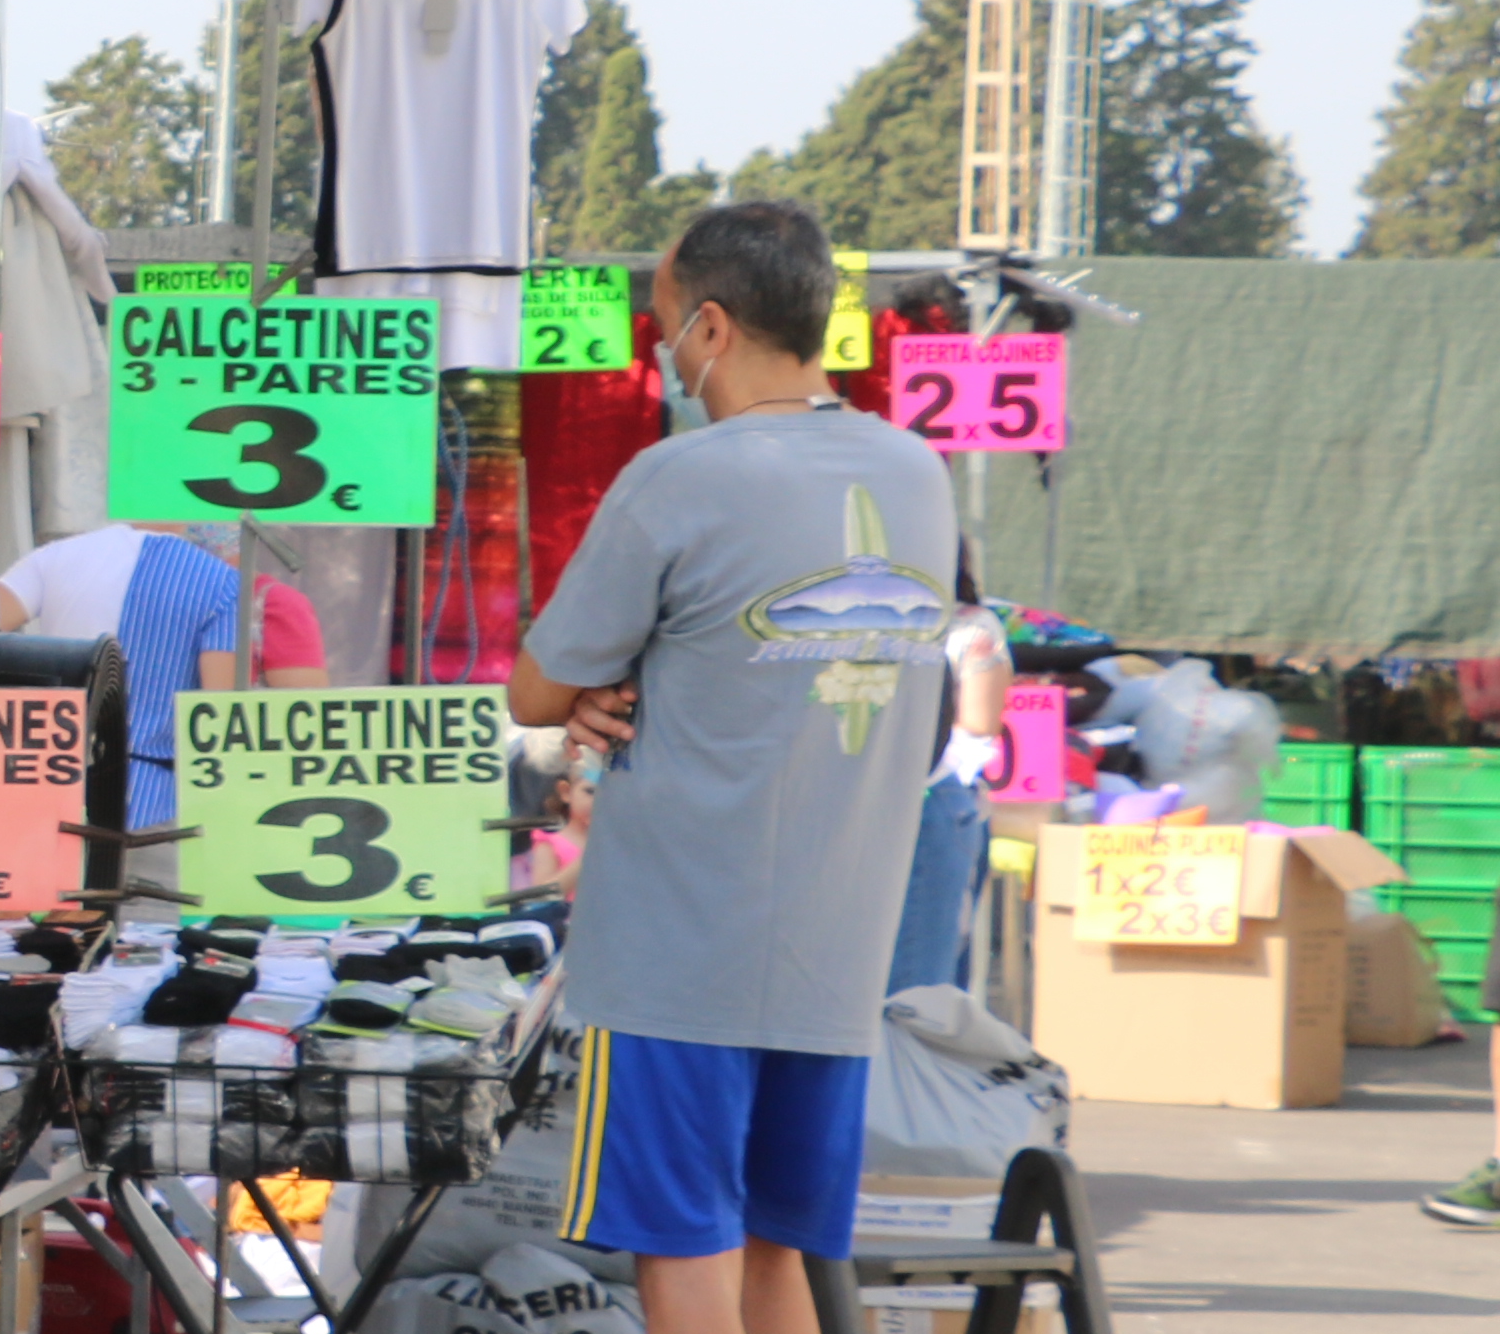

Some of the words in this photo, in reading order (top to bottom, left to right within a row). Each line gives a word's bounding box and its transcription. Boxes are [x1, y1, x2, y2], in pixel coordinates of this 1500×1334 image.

[529, 266, 614, 288] ERTA
[122, 306, 434, 361] CALCETINES
[902, 343, 972, 364] OFERTA
[977, 341, 1057, 364] COJINES
[122, 361, 157, 393] 3
[222, 363, 436, 396] PARES
[905, 371, 954, 439] 2
[189, 697, 499, 753] CALCETINES
[190, 757, 225, 788] 3
[291, 752, 504, 787] PARES
